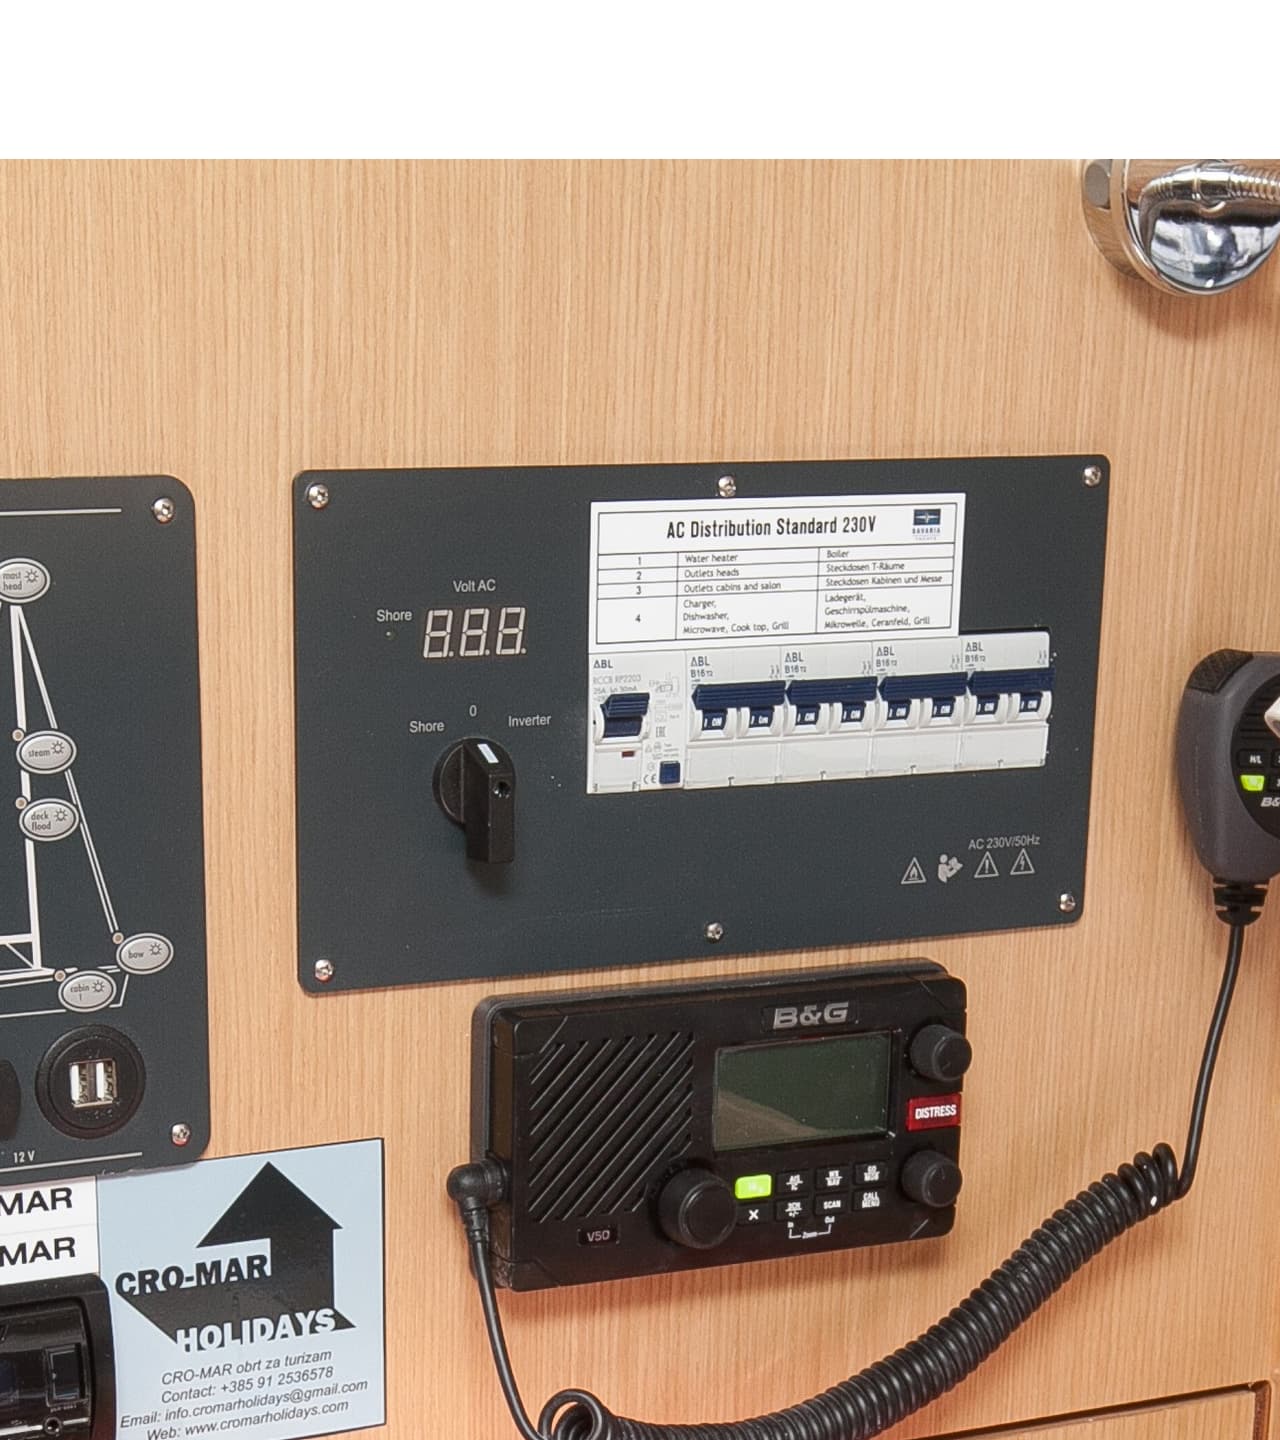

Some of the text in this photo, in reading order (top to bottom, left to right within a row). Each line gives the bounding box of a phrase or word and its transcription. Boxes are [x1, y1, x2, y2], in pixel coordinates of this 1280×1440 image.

[667, 516, 876, 538] AC Distribution Standard 230V
[712, 554, 738, 562] heater
[827, 550, 850, 558] Boiler
[827, 562, 904, 572] Steckdosen T-Räume
[637, 568, 739, 580] 2 Outlets heads
[4, 582, 22, 591] head
[453, 579, 496, 593] Volt AC
[826, 578, 869, 586] Steckdosen
[872, 576, 902, 584] Kabinen
[637, 586, 641, 594] 3
[761, 582, 781, 590] salon
[683, 600, 716, 608] Charger,
[825, 593, 866, 603] Ladegerät,
[377, 609, 412, 622] Shore
[636, 614, 641, 622] 4
[683, 613, 728, 621] Dishwasher,
[683, 622, 789, 634] Microwave, Cook top, Grill
[824, 617, 930, 629] Mikrowelle, Ceranfeld, Grill
[784, 665, 799, 673] B16
[876, 659, 889, 667] B16
[691, 669, 704, 678] B16
[410, 721, 445, 733] Shore
[509, 715, 551, 728] Inverter
[32, 811, 48, 820] deck
[32, 822, 51, 830] flood
[968, 834, 1040, 850] AC 230V/50Hz
[129, 950, 144, 959] bow
[71, 984, 89, 993] cabin
[773, 1002, 849, 1030] B&G
[915, 1105, 956, 1120] DISTRESS
[14, 1151, 35, 1163] 12 V
[863, 1192, 879, 1200] CALL
[824, 1200, 841, 1209] SCAN
[862, 1199, 880, 1208] MENU
[587, 1230, 610, 1242] V50
[115, 1255, 268, 1295] CRO-MAR
[175, 1308, 336, 1351] HOLIDAYS
[162, 1351, 332, 1386] CRO-MAR obrt za turizam
[161, 1366, 333, 1404] Contact: +385 91 2536578
[121, 1380, 368, 1429] Email: info.cromarholidays@gmail.com
[147, 1400, 348, 1440] Web: www.cromarholidays.com
